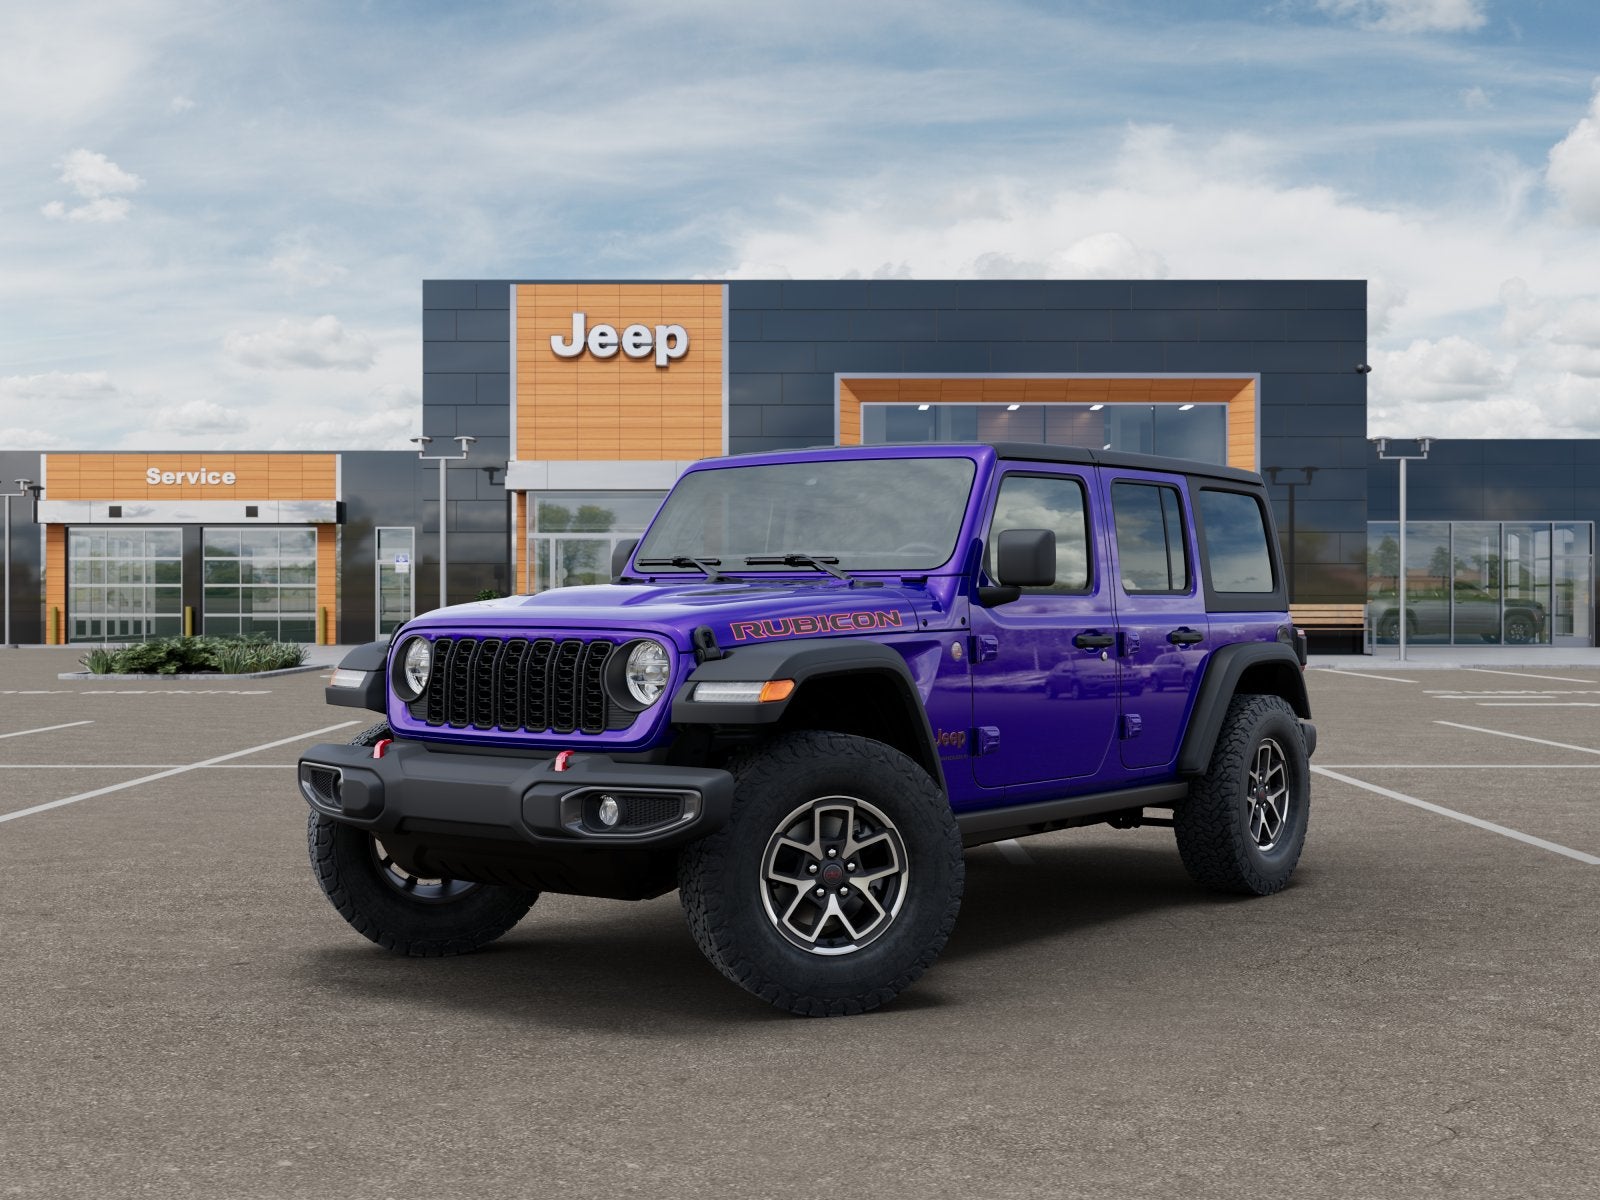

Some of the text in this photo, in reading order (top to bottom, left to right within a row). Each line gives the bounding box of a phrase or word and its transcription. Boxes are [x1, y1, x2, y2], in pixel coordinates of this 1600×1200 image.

[550, 312, 688, 367] Jeep
[146, 467, 236, 485] Service
[730, 610, 902, 640] RUBICON
[935, 728, 966, 748] Jeep
